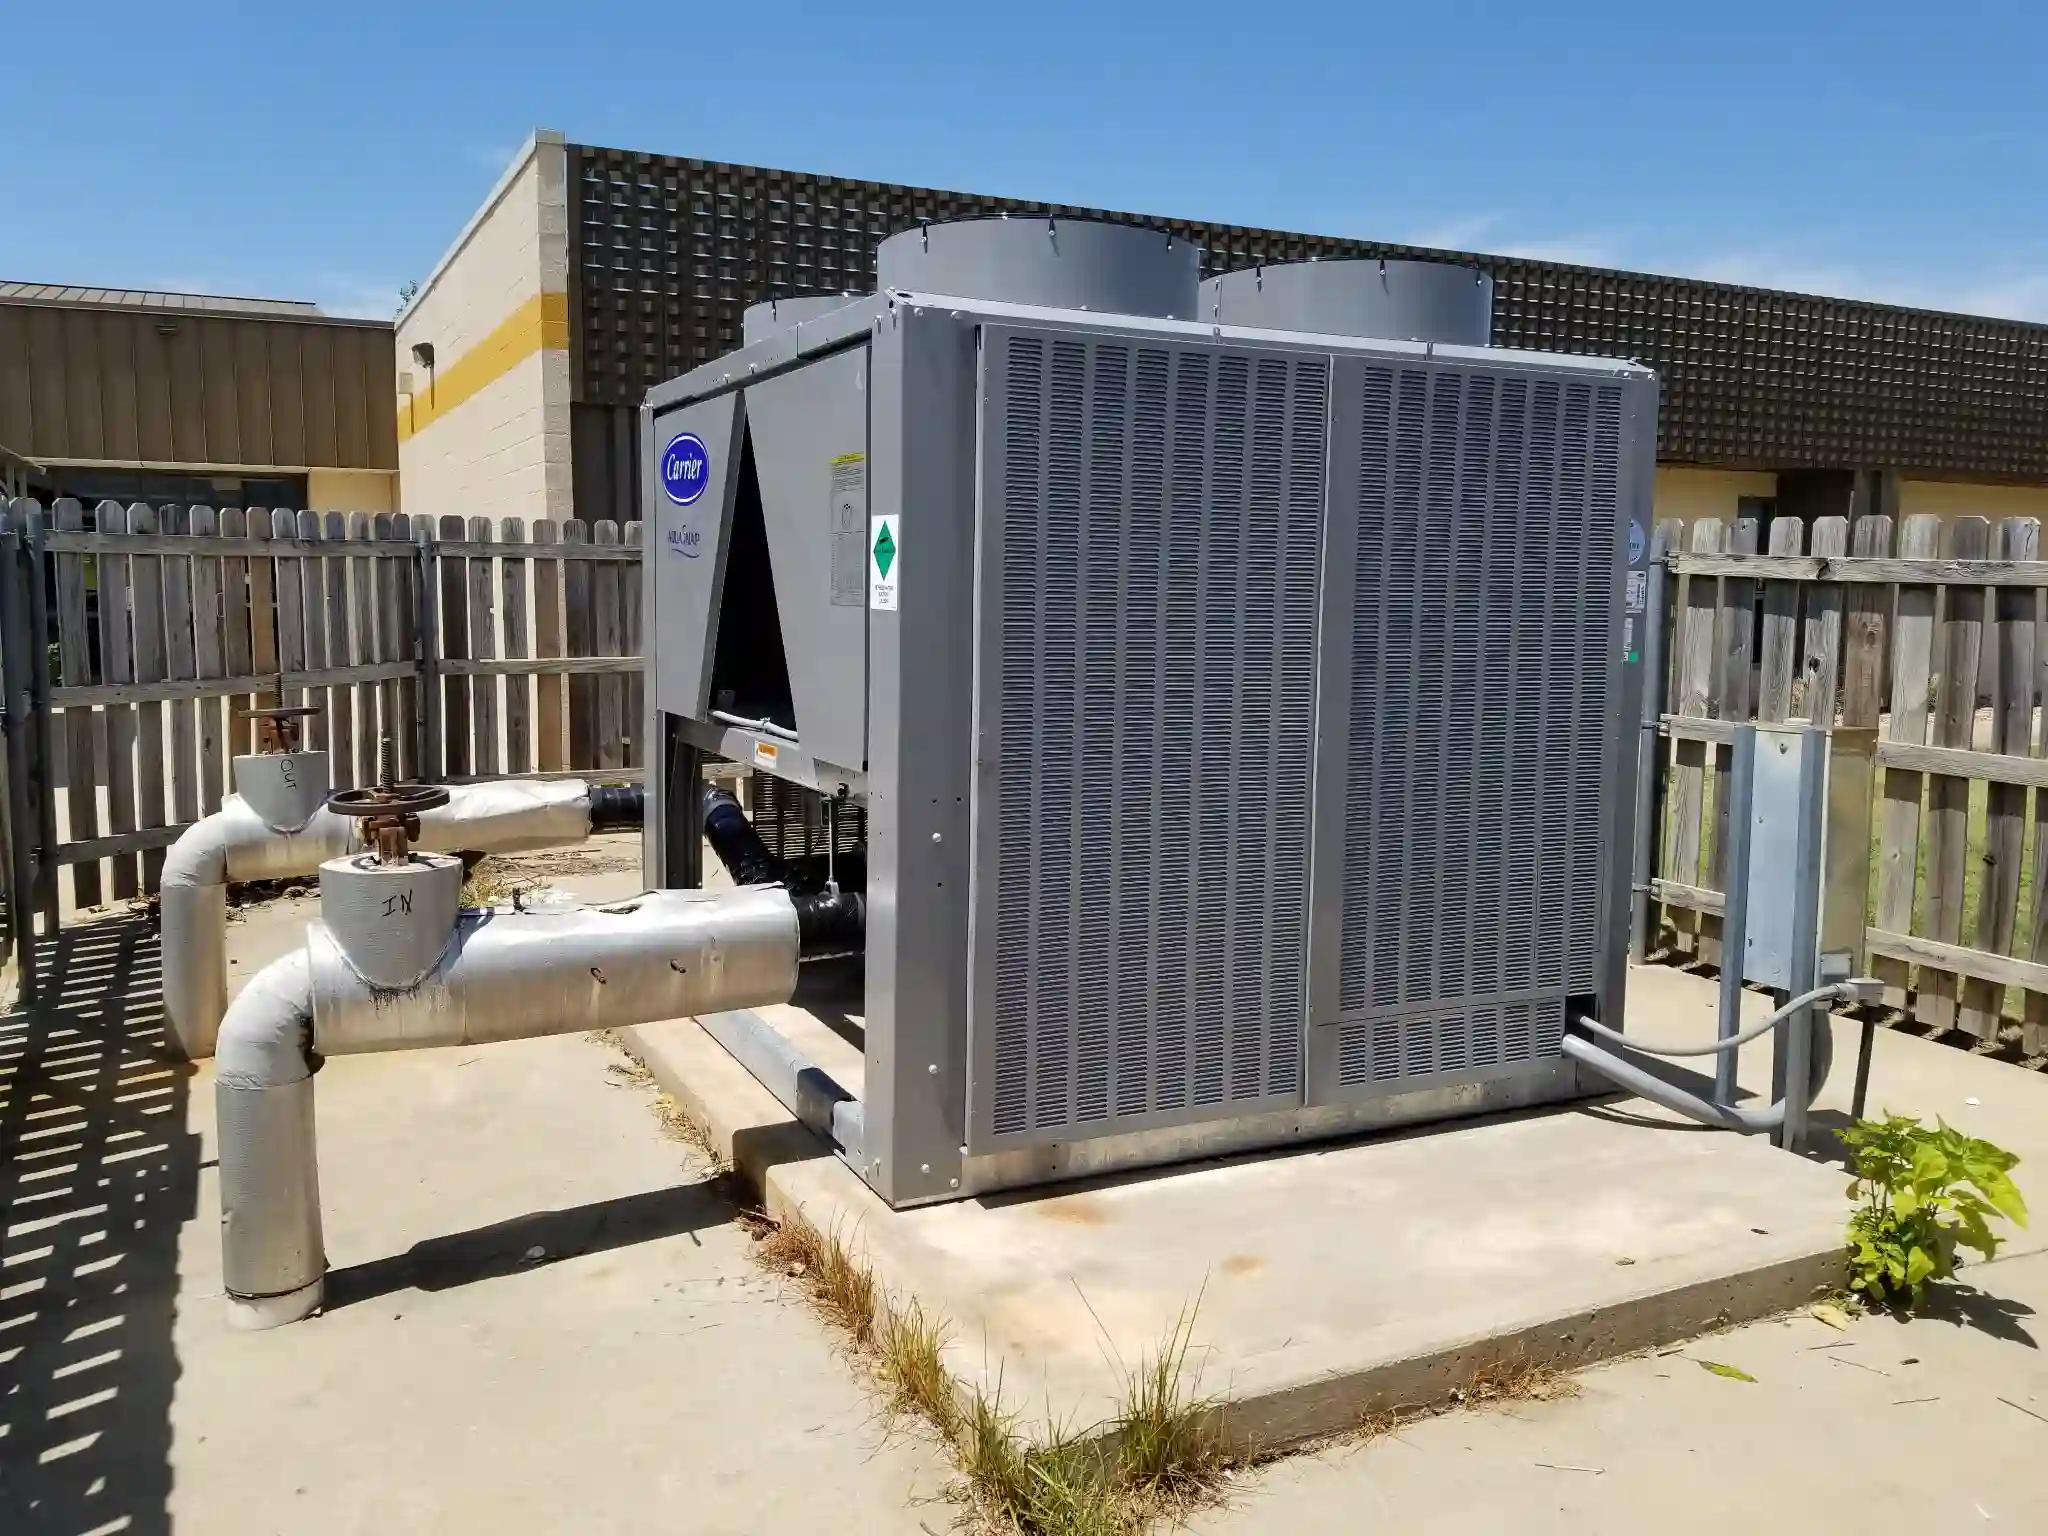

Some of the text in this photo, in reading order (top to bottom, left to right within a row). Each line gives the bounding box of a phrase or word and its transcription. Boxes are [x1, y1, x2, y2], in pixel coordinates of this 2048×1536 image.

[666, 453, 702, 481] Carrier
[280, 758, 297, 790] OUT
[382, 888, 412, 917] IN
